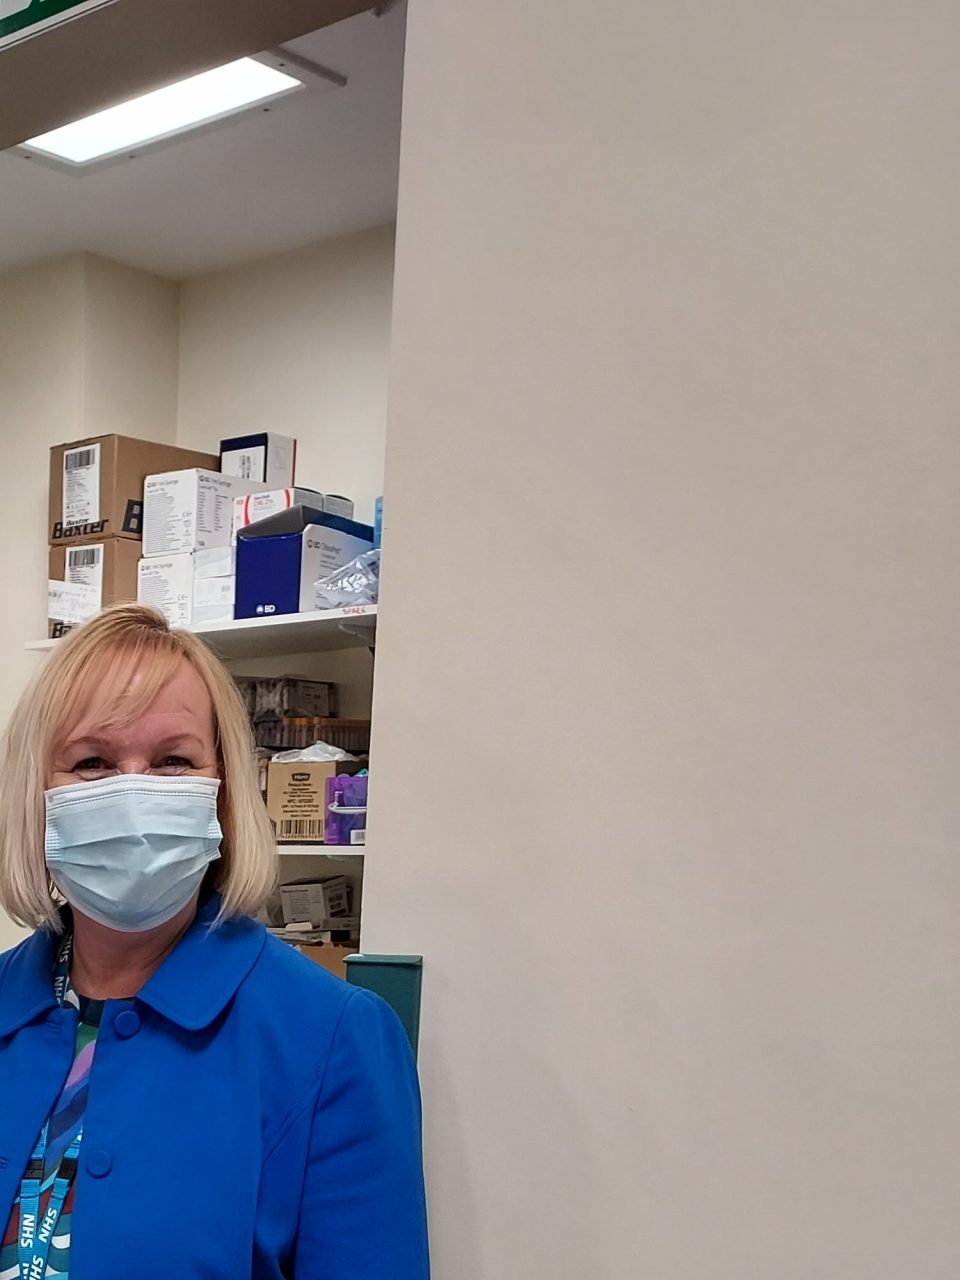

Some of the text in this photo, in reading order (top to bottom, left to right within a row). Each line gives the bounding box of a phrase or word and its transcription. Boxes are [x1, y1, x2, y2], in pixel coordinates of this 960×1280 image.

[52, 519, 109, 539] Baxter
[264, 604, 276, 613] BD
[20, 1213, 35, 1248] NHS
[38, 1207, 58, 1243] NHS
